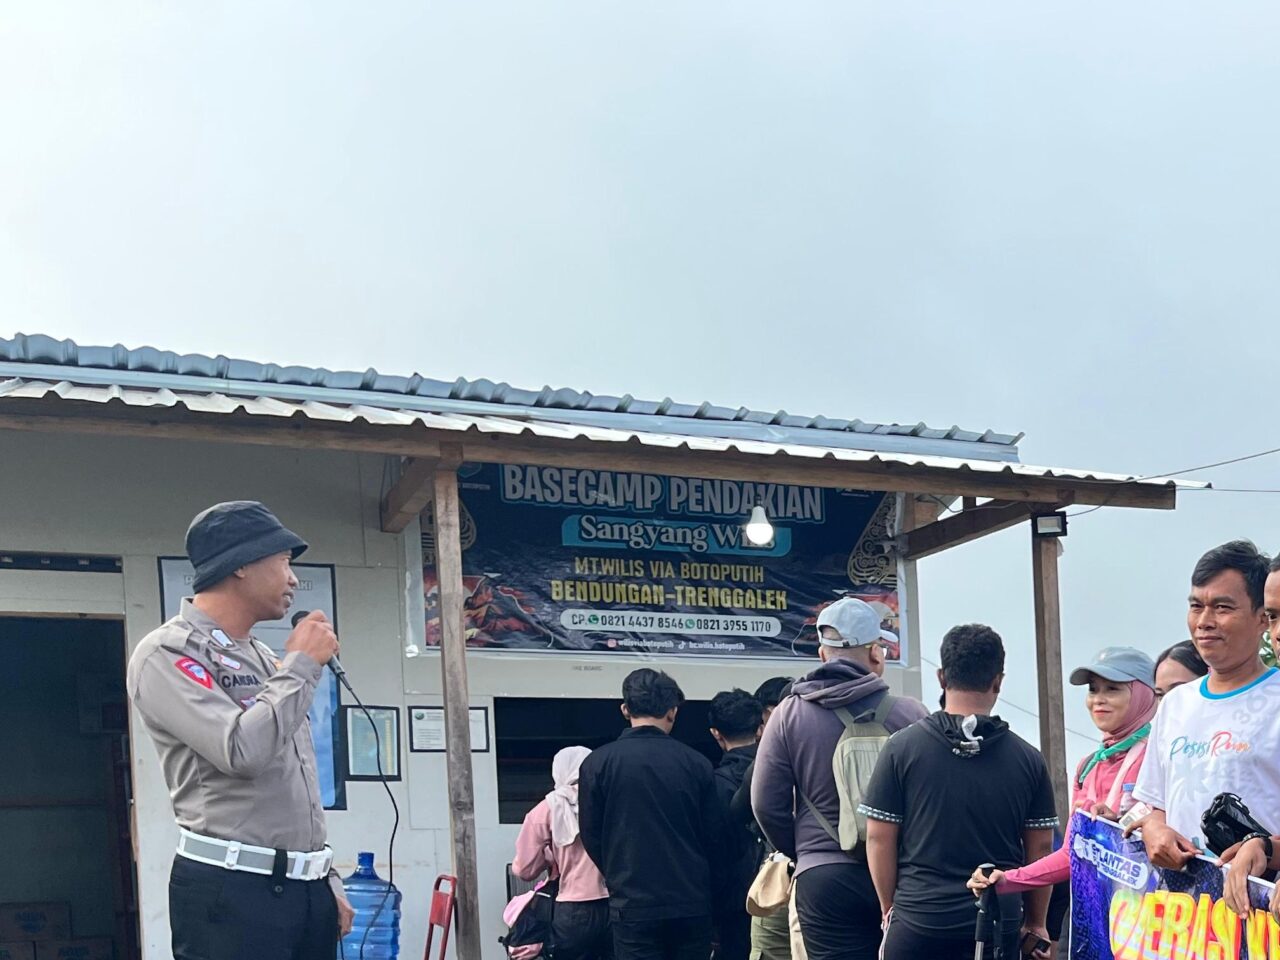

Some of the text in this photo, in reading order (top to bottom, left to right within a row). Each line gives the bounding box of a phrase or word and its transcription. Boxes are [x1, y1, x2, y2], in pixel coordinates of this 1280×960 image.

[503, 463, 824, 521] BASECAMP PENDAKIAN
[580, 514, 708, 552] Sangyang
[650, 562, 676, 579] VIA
[680, 562, 764, 583] BOTOPUTIH
[551, 579, 788, 610] BENDUNGAN-TRENGGALEK
[601, 615, 625, 627] 0821
[628, 616, 655, 628] 4437
[658, 617, 684, 630] 8546
[696, 618, 721, 631] 0821
[722, 619, 748, 632] 3955
[751, 620, 772, 633] 1170
